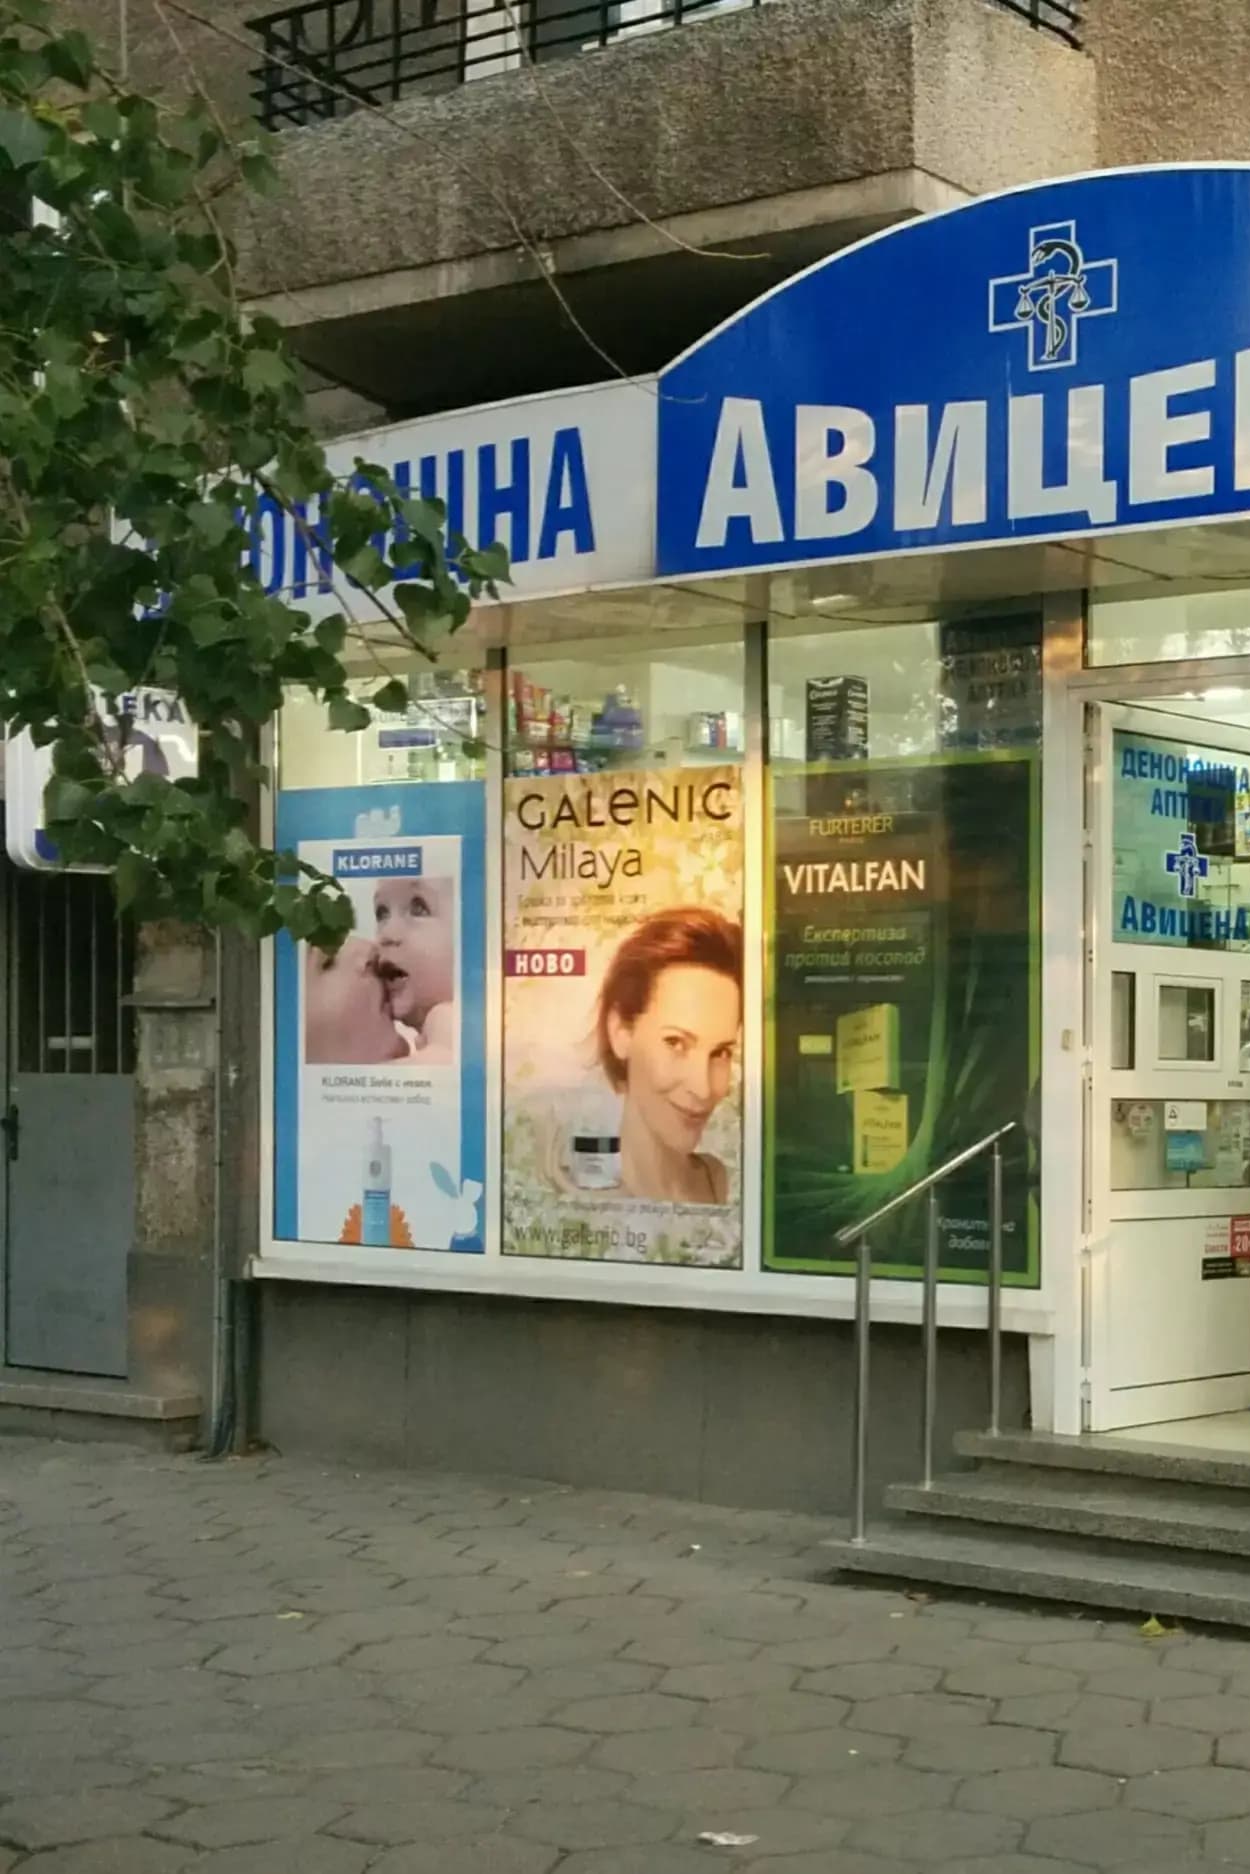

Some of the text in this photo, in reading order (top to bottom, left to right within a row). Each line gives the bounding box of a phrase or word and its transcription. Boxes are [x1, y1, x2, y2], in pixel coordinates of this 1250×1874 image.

[809, 815, 894, 836] FURTERER
[338, 853, 418, 870] KLORANE
[521, 843, 643, 889] Milaya
[784, 860, 925, 894] VITALFAN
[1121, 895, 1249, 941] АВИЦЕНА
[515, 953, 574, 974] НОВО
